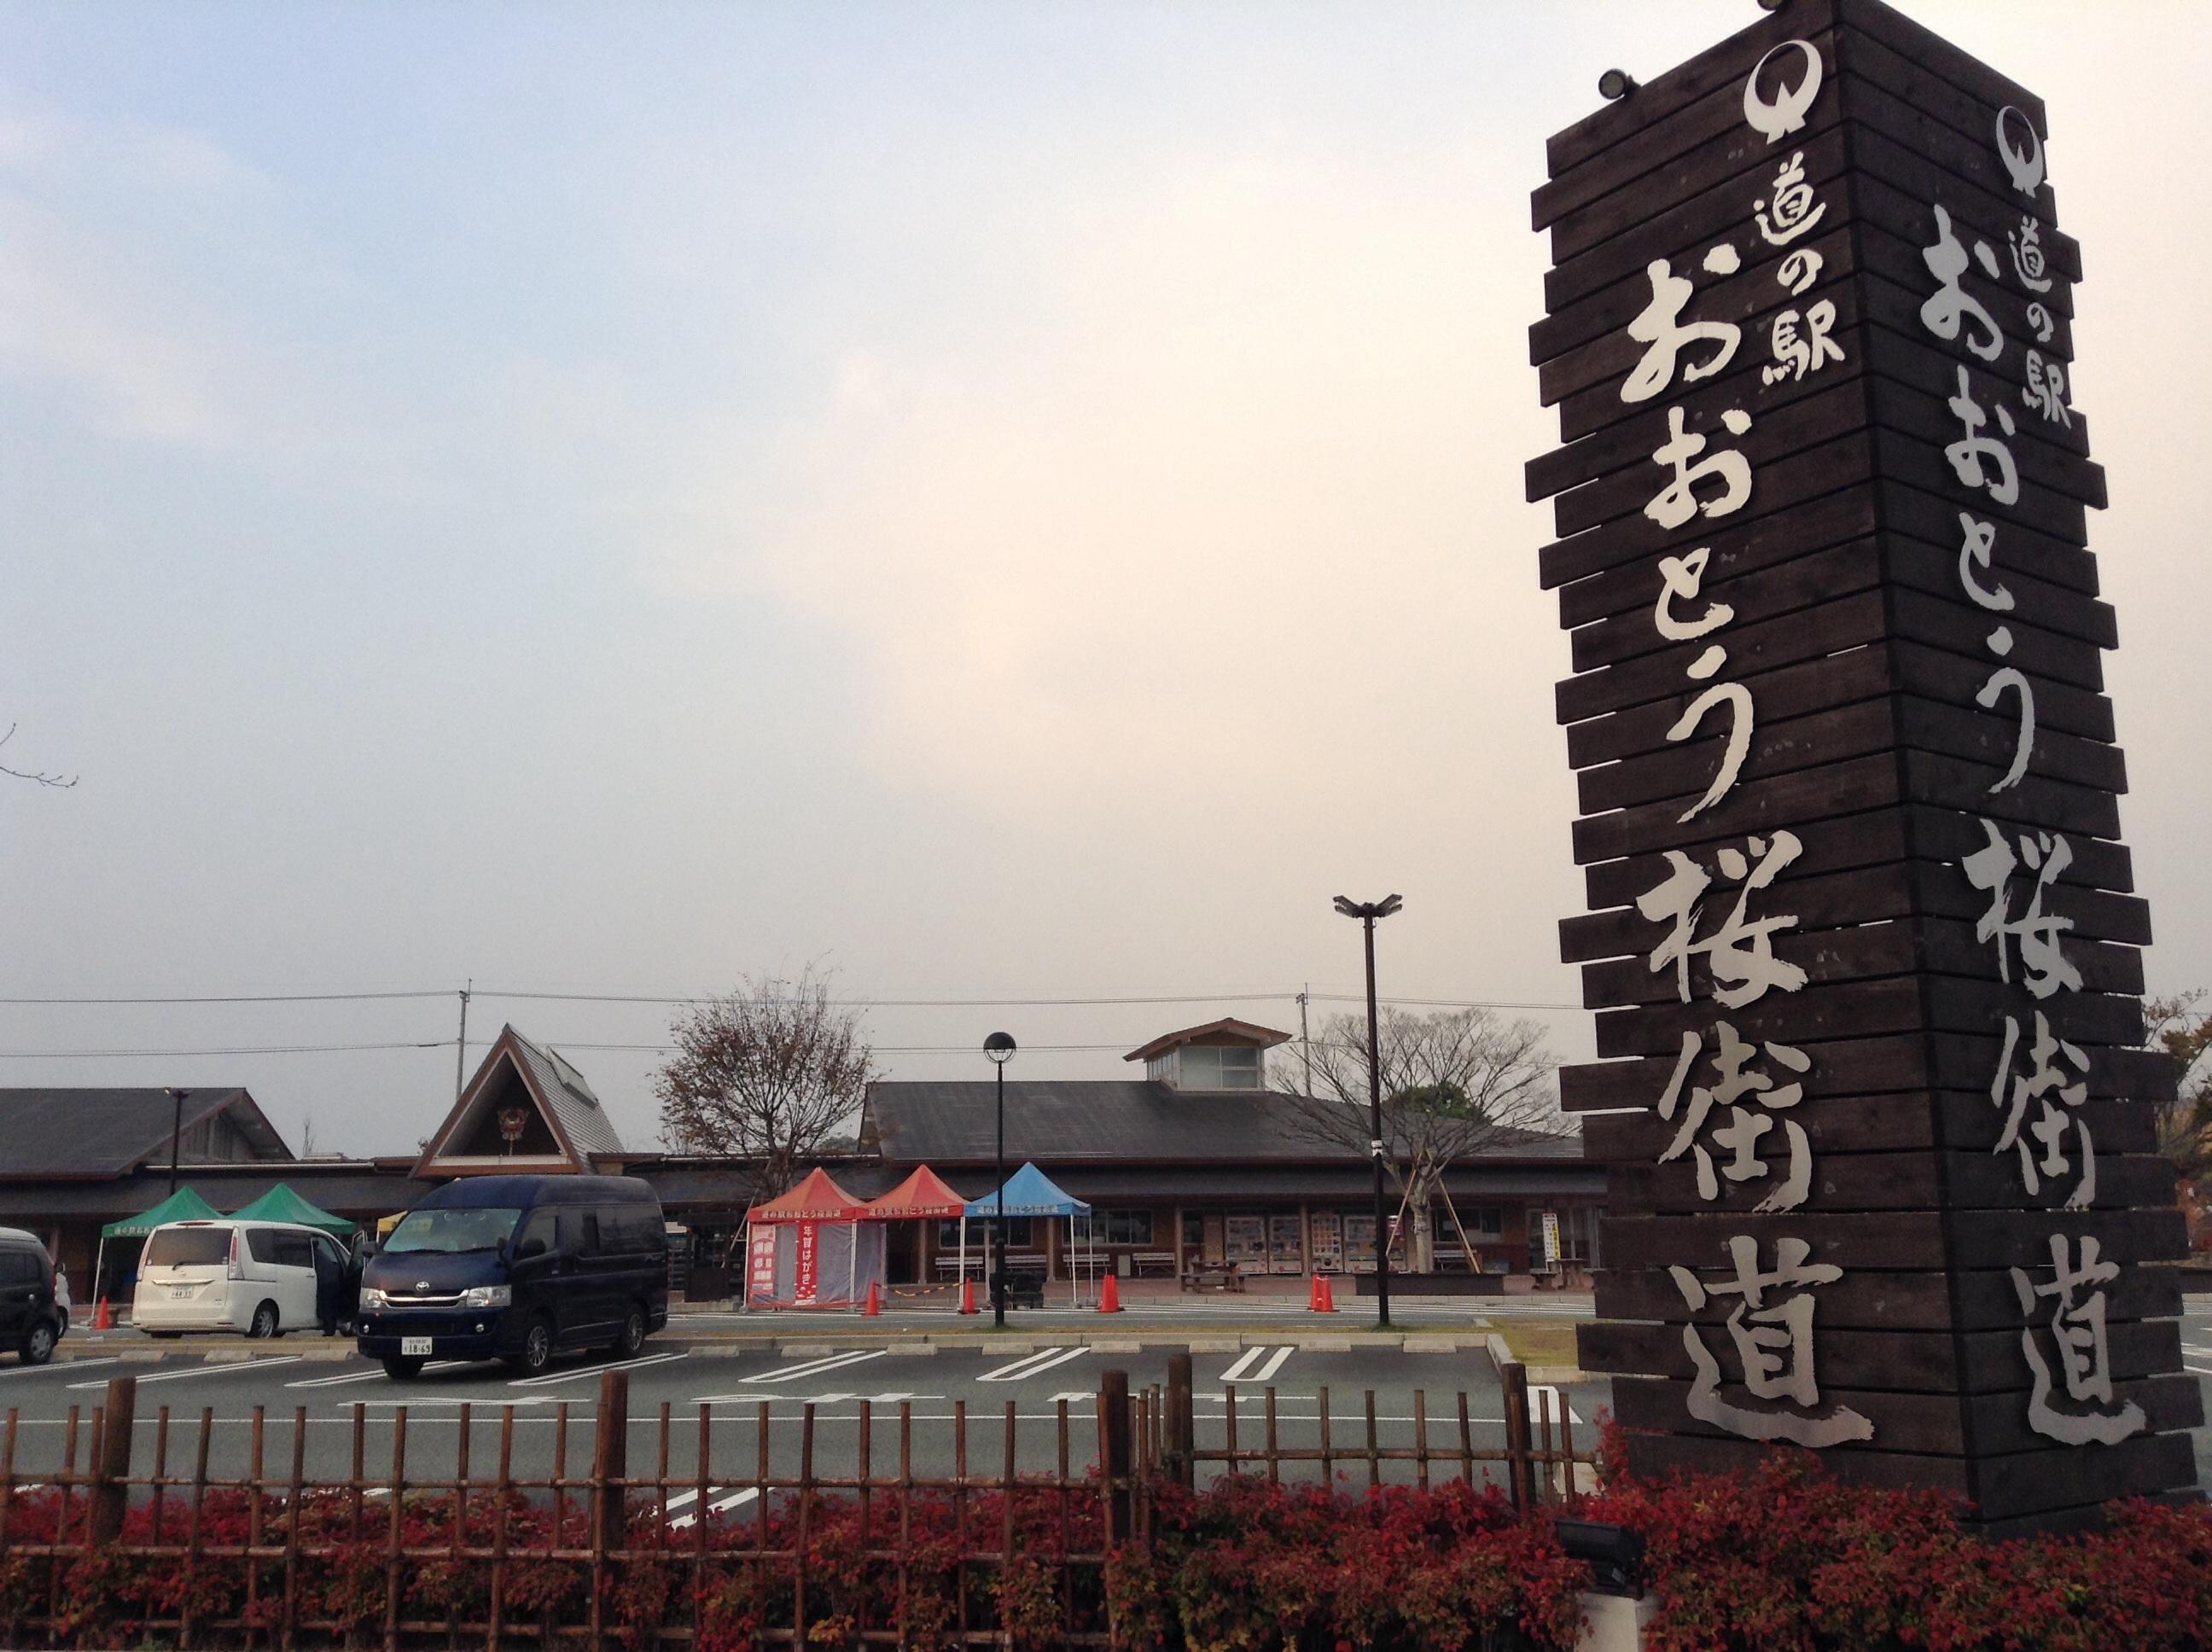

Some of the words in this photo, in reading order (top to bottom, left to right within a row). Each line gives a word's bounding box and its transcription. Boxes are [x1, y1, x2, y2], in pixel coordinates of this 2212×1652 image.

[1754, 152, 1846, 387] 道の駅
[2007, 215, 2071, 430] 道の駅
[1620, 243, 1875, 1449] おおとう桜街道
[1921, 204, 2146, 1446] おおとう桜街道
